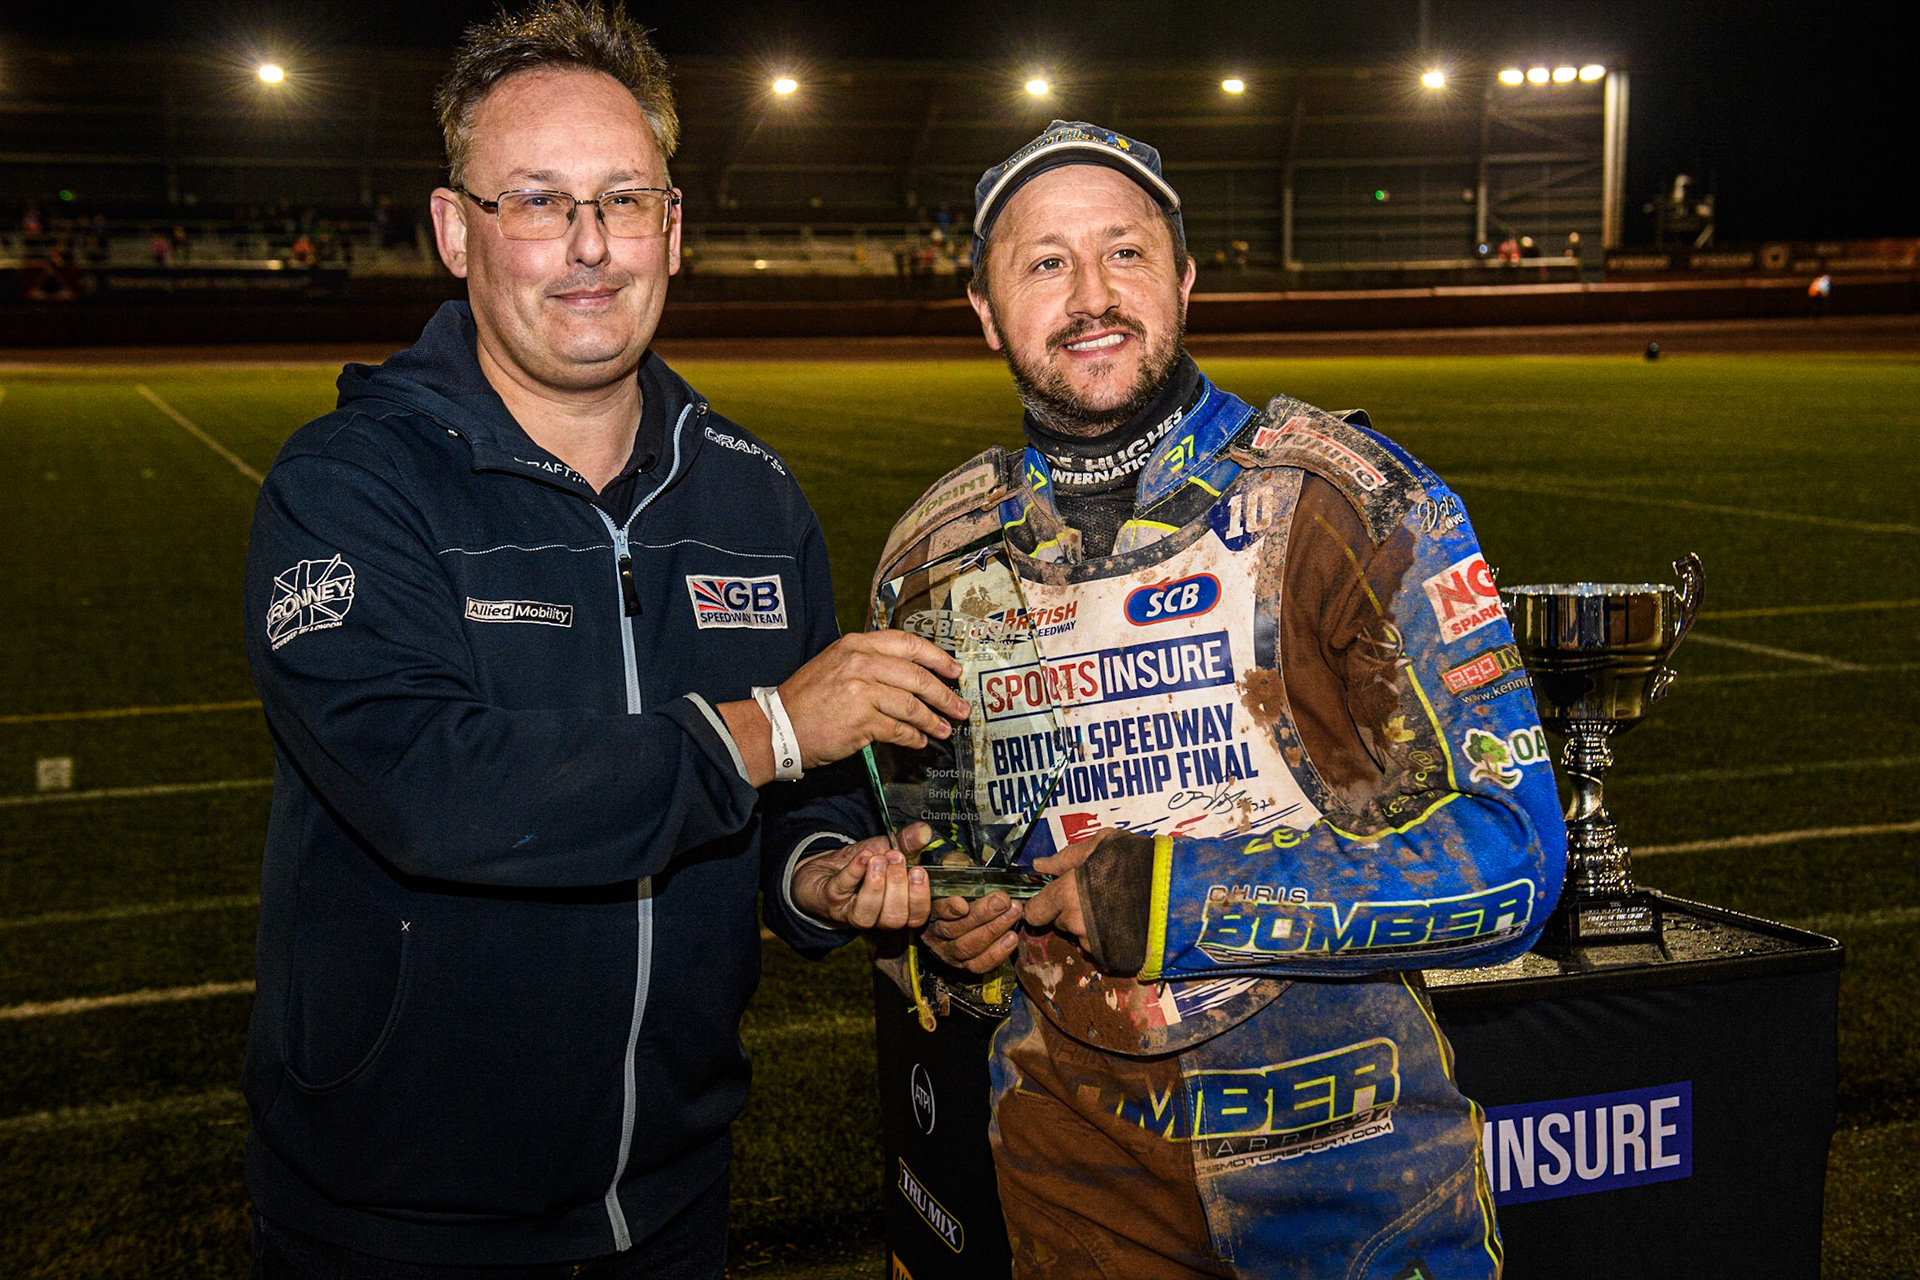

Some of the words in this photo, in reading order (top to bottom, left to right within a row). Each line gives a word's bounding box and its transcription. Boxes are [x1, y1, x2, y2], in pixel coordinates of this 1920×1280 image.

[1084, 405, 1183, 473] HUGHES
[1225, 486, 1275, 540] 10
[268, 579, 351, 627] RONNEY
[470, 603, 514, 617] Allied
[515, 605, 569, 623] Mobility
[700, 612, 751, 624] SPEEDWAY
[753, 613, 784, 624] TEAM
[723, 581, 780, 612] GB
[1146, 583, 1200, 617] SCB
[985, 660, 1099, 714] SPORTS
[1103, 640, 1227, 695] INSURE
[991, 725, 1085, 776] BRITISH
[1088, 703, 1234, 761] SPEEDWAY
[926, 766, 960, 779] Sports
[929, 788, 962, 800] British
[988, 754, 1172, 816] CHAMPIONSHIP
[1175, 742, 1260, 789] FINAL
[1199, 880, 1534, 958] BOMBER
[1209, 887, 1308, 903] CHRIS
[1483, 1096, 1680, 1192] INSURE
[903, 1169, 927, 1213] TRU
[928, 1201, 957, 1245] MIX
